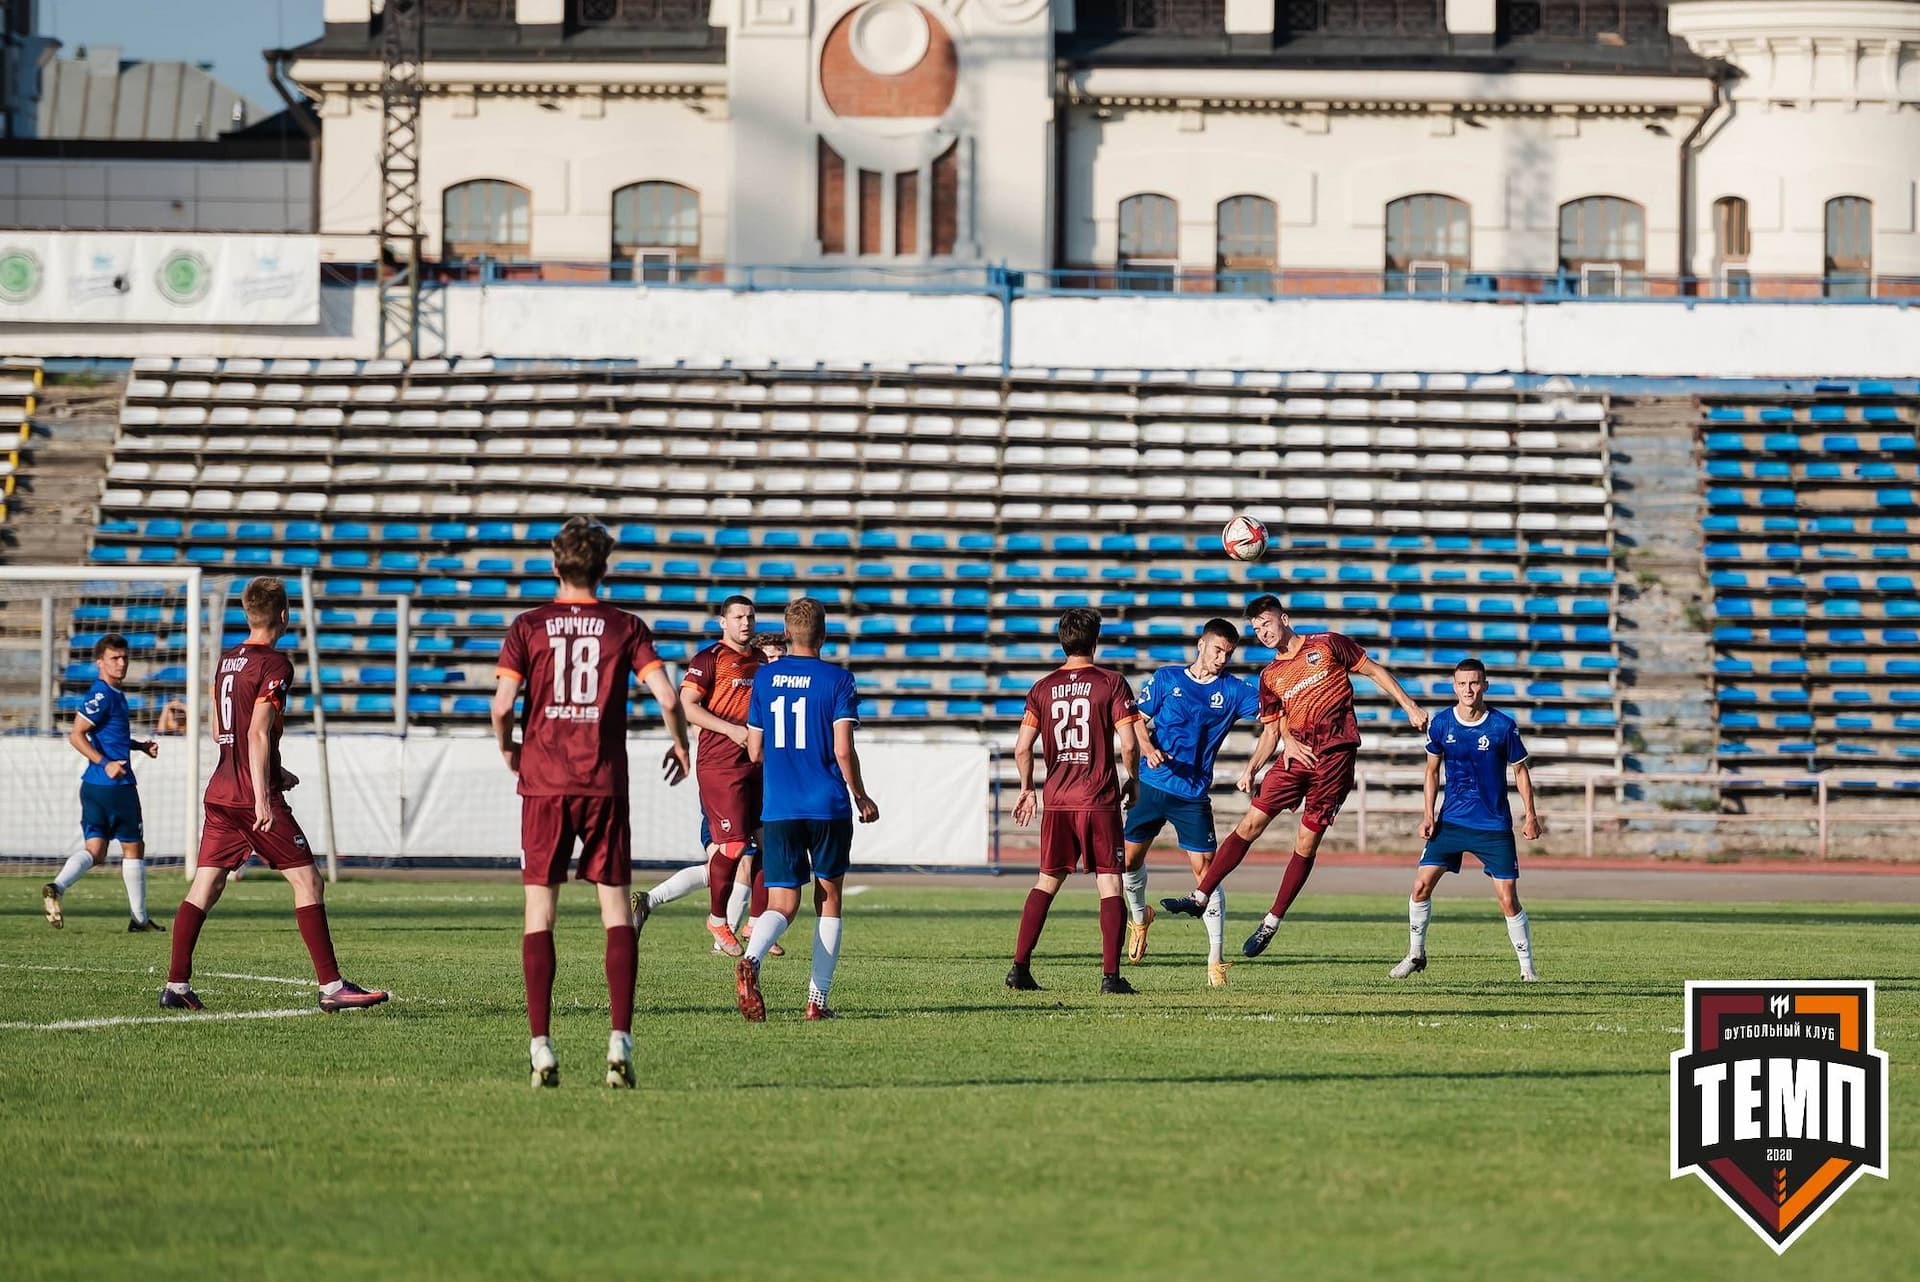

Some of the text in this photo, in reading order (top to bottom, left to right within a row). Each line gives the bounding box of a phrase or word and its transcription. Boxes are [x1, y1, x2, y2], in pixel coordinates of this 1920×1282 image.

[549, 637, 600, 704] 18
[772, 674, 811, 689] ЯРКИН
[1051, 681, 1092, 700] ВОРОНА
[220, 674, 234, 731] 6
[770, 695, 808, 750] 11
[1051, 697, 1091, 752] 23
